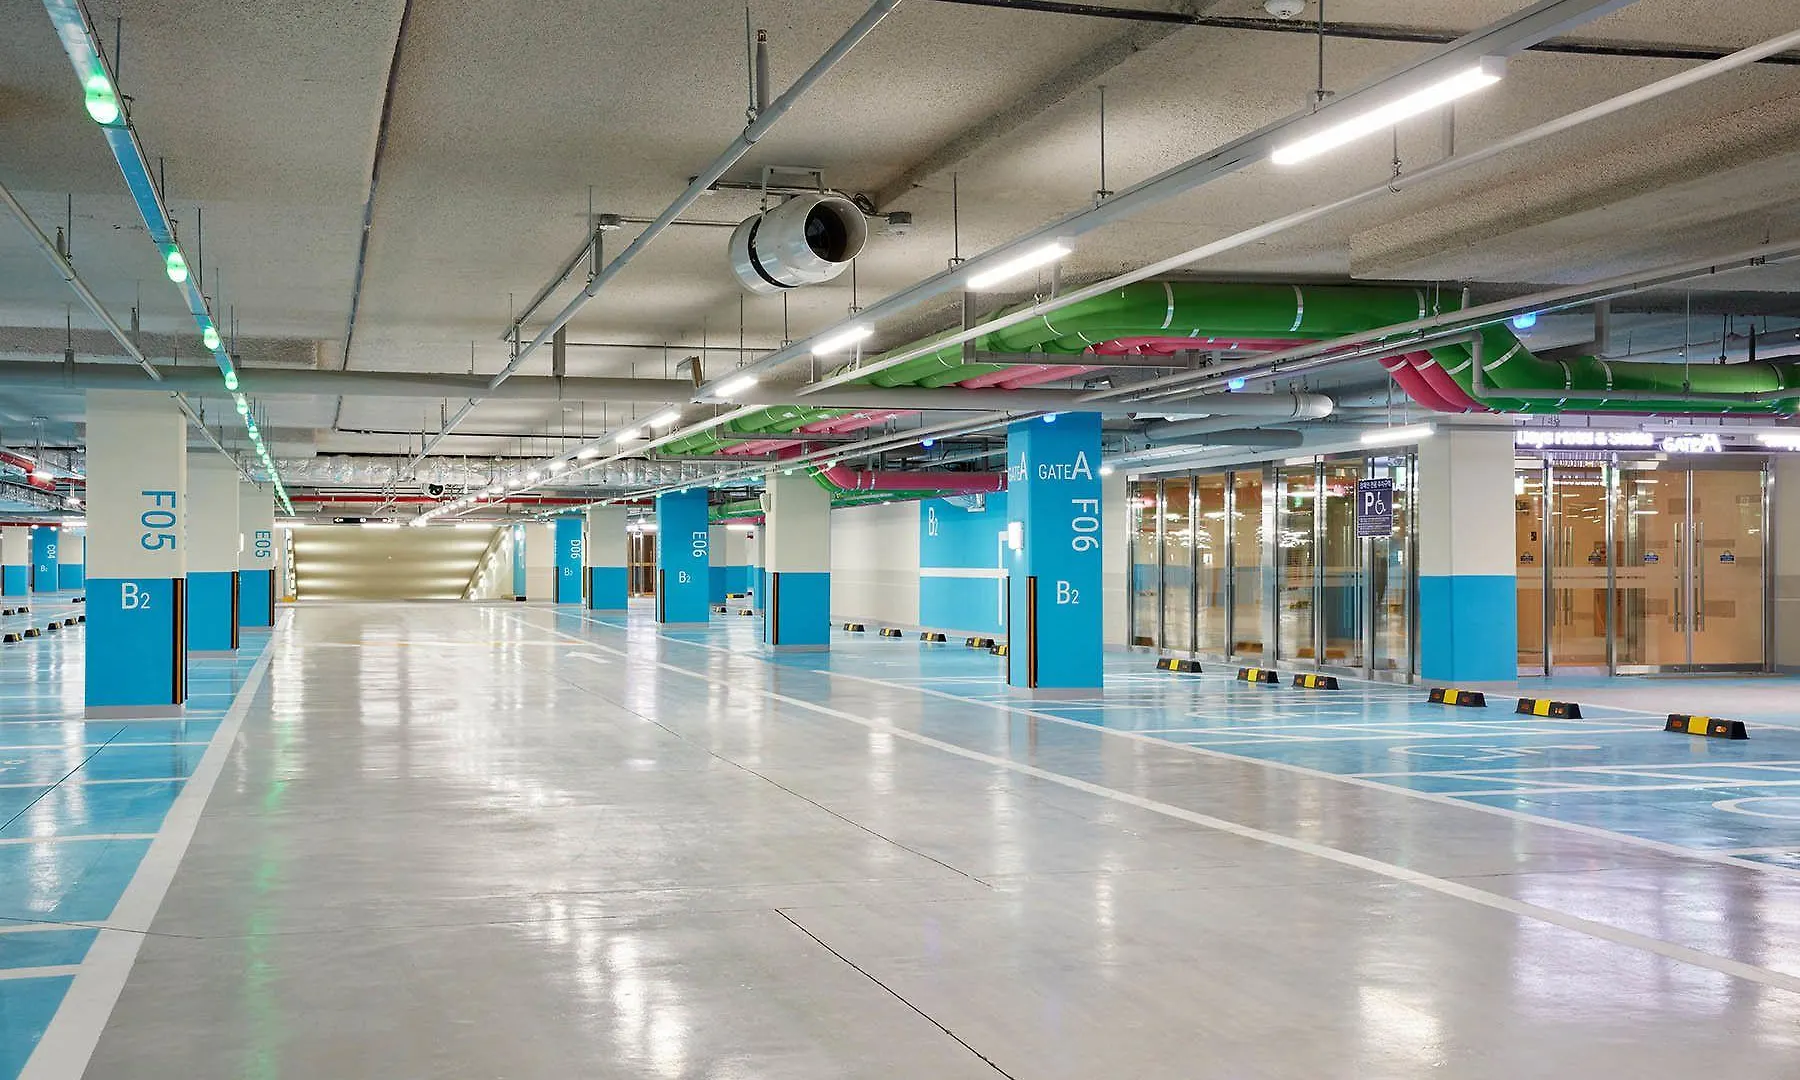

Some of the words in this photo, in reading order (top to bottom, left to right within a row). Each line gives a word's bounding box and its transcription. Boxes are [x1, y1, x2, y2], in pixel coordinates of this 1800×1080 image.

[1365, 491, 1375, 515] P
[141, 490, 177, 550] F05
[928, 507, 938, 536] B2
[1071, 498, 1099, 552] F06
[255, 530, 271, 558] E05
[570, 539, 581, 559] D06
[692, 531, 707, 558] E06
[678, 571, 692, 583] B2
[121, 582, 151, 610] B2
[1056, 580, 1080, 605] B2
